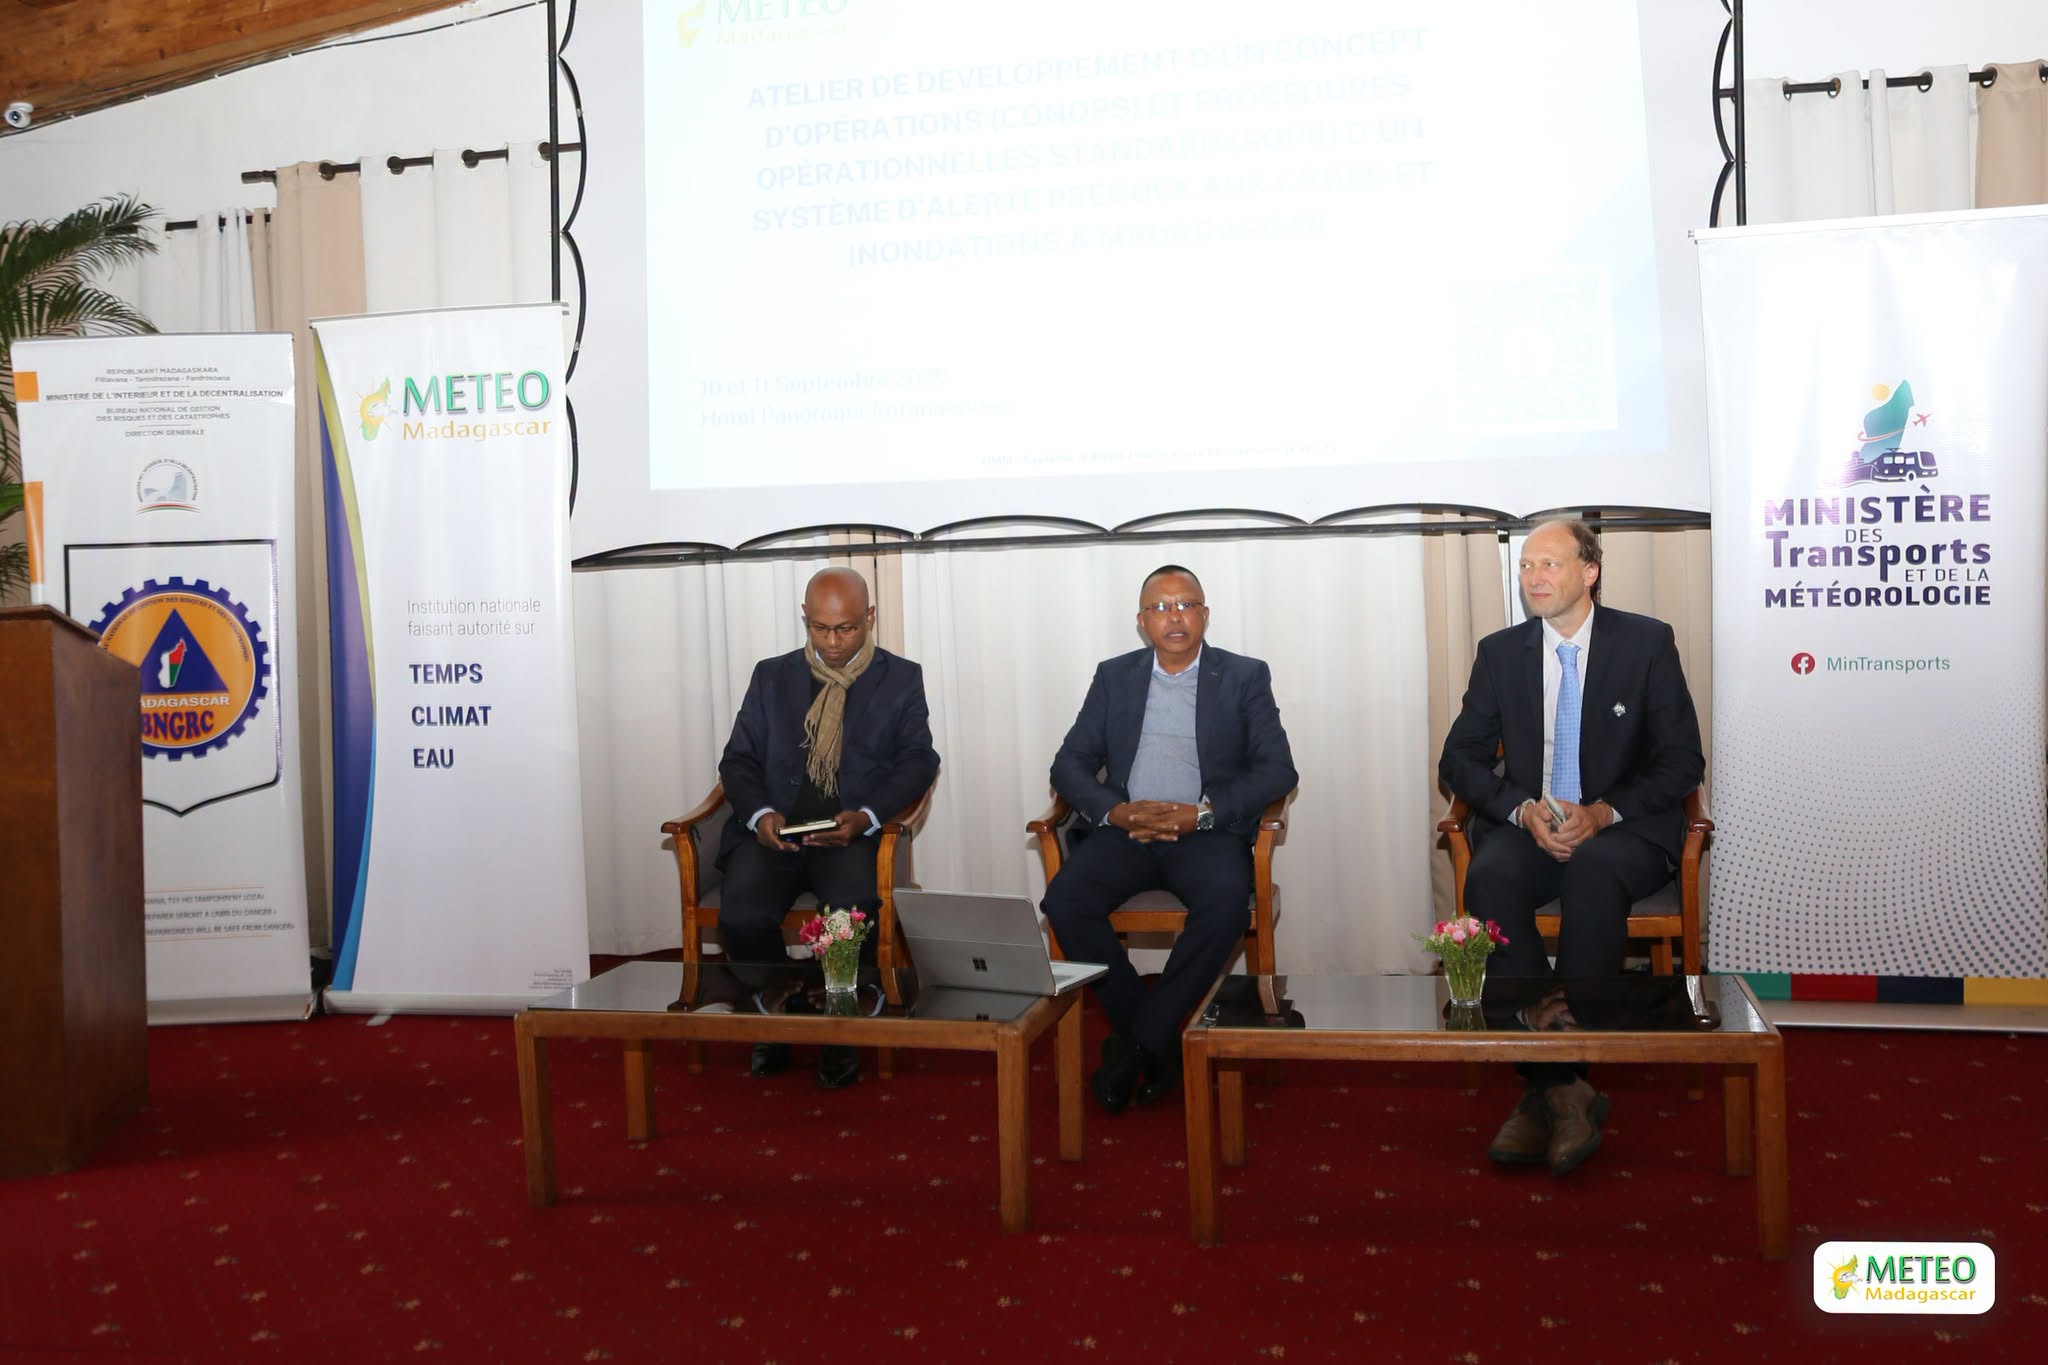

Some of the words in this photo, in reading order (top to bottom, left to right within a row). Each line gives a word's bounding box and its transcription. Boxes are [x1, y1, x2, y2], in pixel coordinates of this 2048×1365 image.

[716, 24, 848, 49] Madagr
[747, 78, 864, 110] ATELIER
[872, 72, 909, 98] DE
[1275, 27, 1428, 64] CONCEPT
[765, 107, 982, 149] D'OPÉRATIONS
[756, 145, 1041, 191] OPÉRATIONNELLES
[752, 198, 889, 233] SYSTÈME
[848, 231, 1060, 269] INONDATIONS
[92, 392, 105, 400] DE
[160, 390, 171, 398] ET
[173, 390, 185, 398] DE
[187, 390, 199, 398] LA
[403, 370, 551, 416] METEO
[402, 420, 552, 442] Madagascar
[1764, 484, 1991, 526] MINISTÈRE
[1845, 528, 1883, 543] DES
[1765, 530, 1991, 583] Transports
[1905, 568, 1927, 582] ET
[1935, 568, 1958, 582] DE
[1966, 568, 1990, 581] LA
[1765, 580, 1991, 608] MÉTÉOROLOGIE
[407, 598, 475, 614] Institution
[480, 597, 541, 613] nationale
[408, 621, 453, 636] faisant
[457, 619, 511, 636] autorité
[515, 622, 536, 635] sur
[408, 663, 483, 684] TEMPS
[1827, 655, 1950, 674] MinTransports
[140, 695, 230, 709] ADAGASCAR
[411, 705, 492, 727] CLIMAT
[413, 748, 454, 769] EAU
